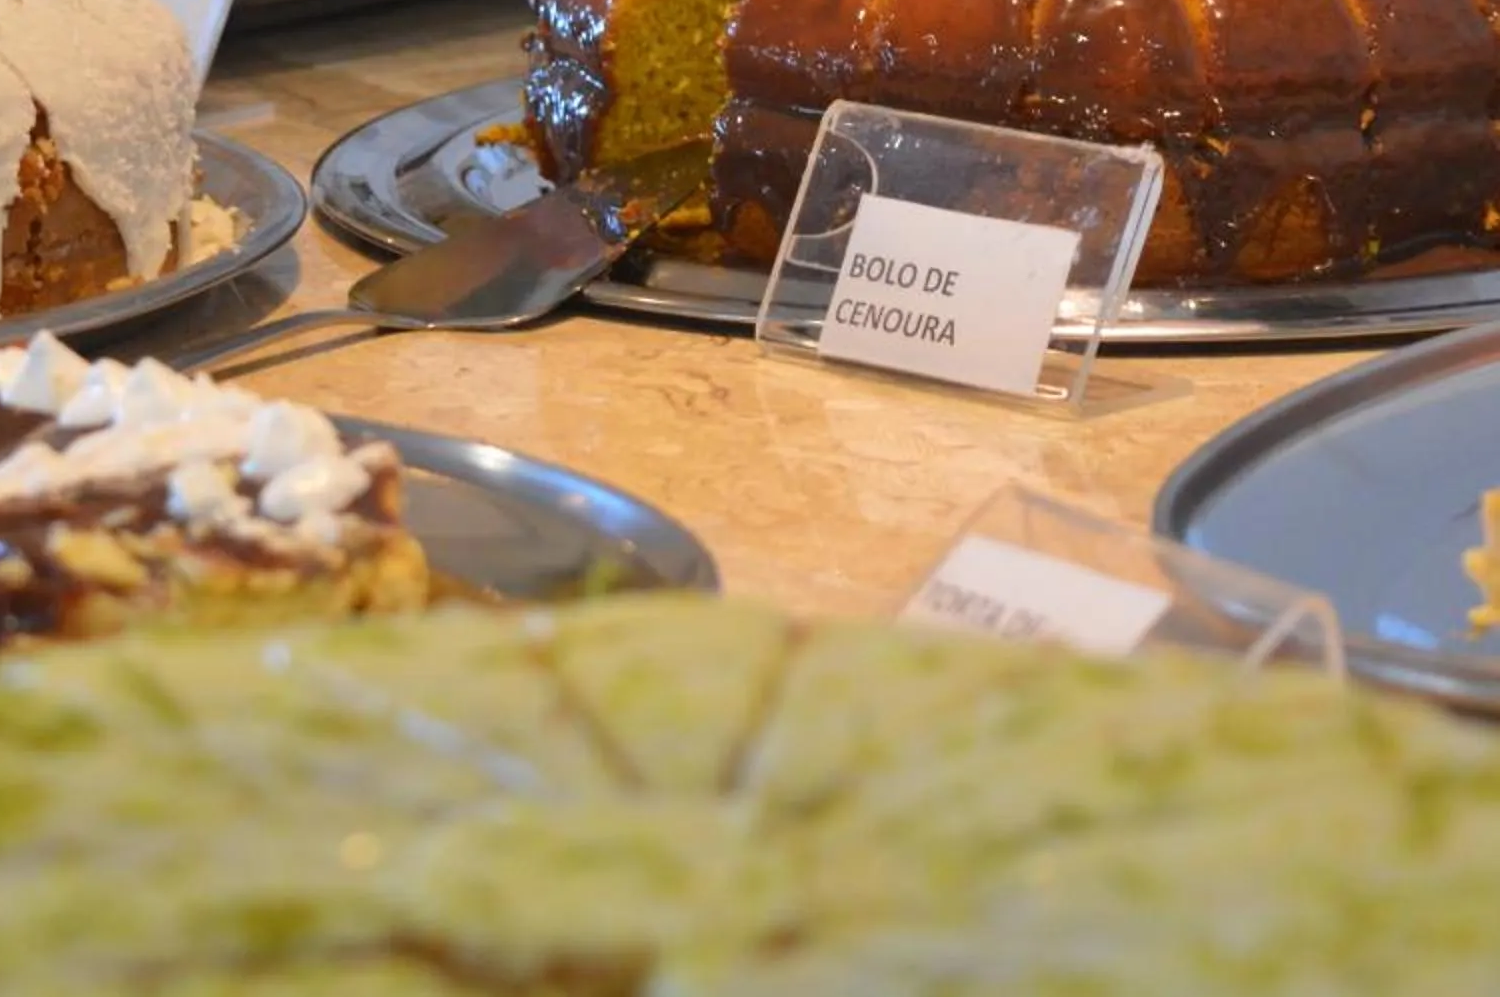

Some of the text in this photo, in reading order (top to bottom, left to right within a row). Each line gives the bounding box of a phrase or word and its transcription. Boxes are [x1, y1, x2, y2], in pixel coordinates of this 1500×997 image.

[849, 253, 960, 297] BOLO DE
[834, 298, 956, 347] CENOURA
